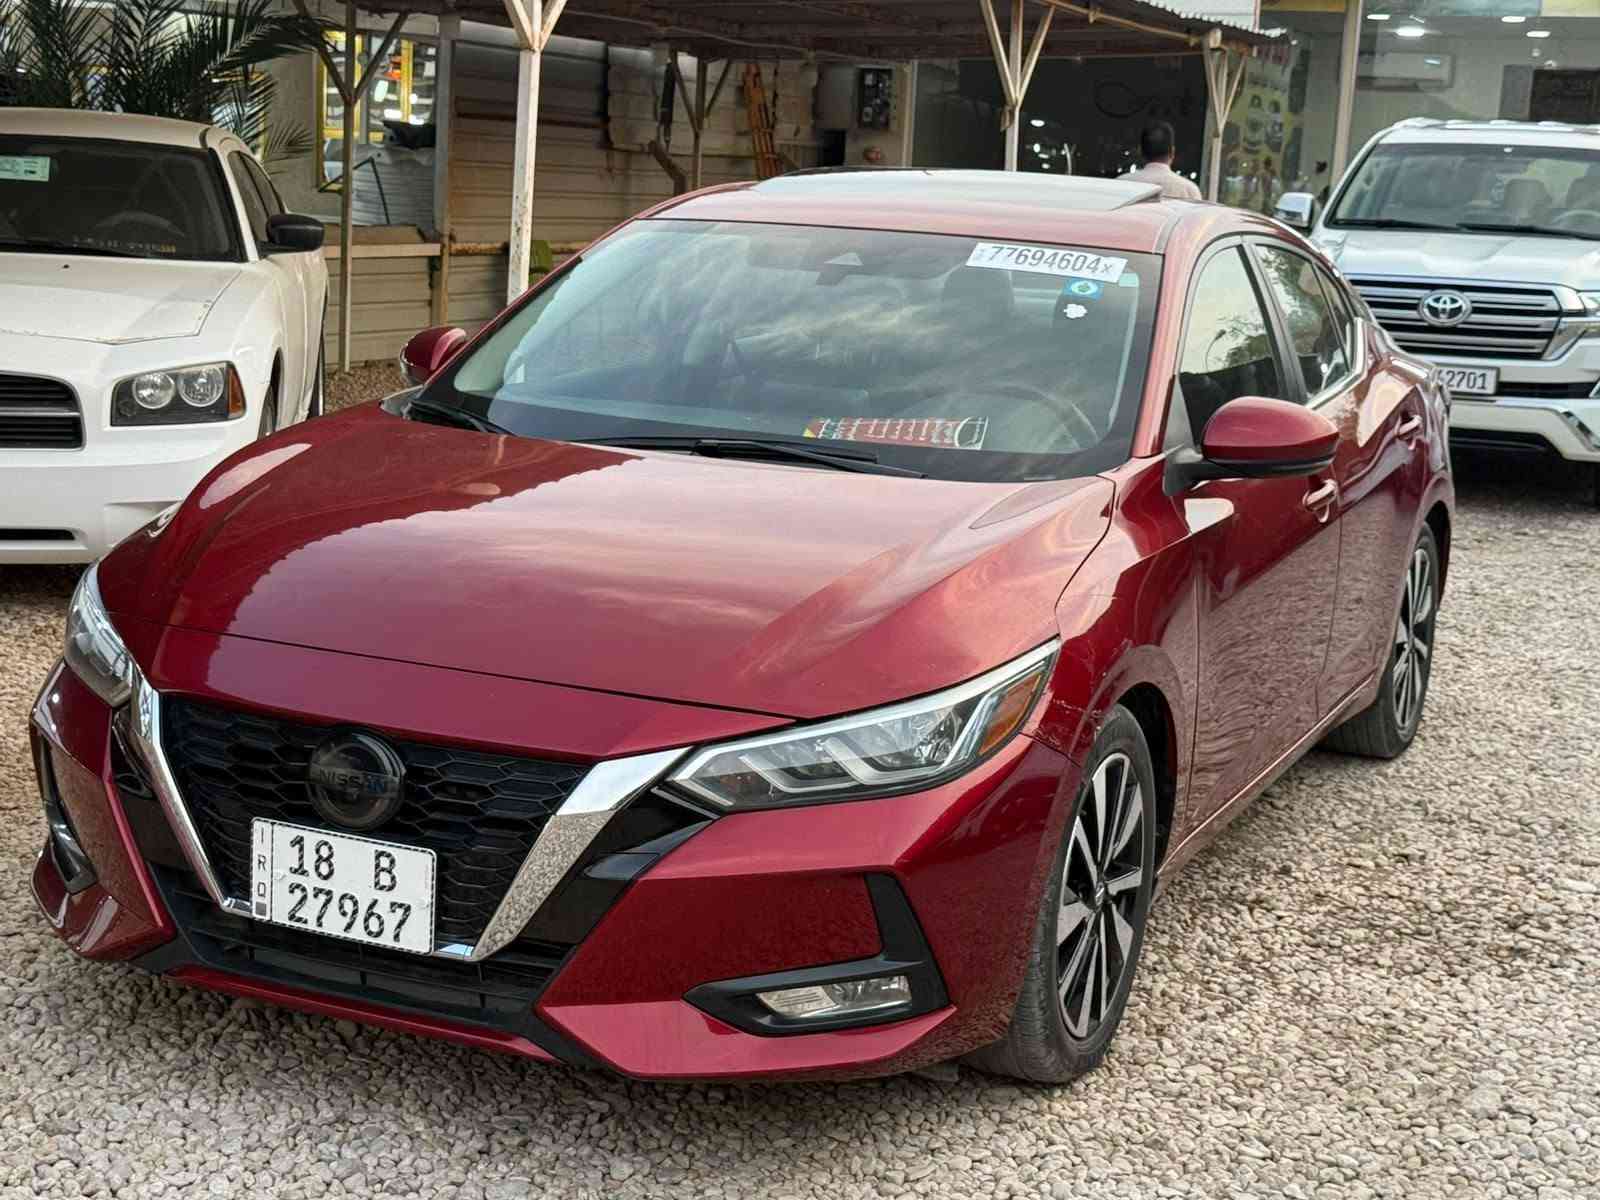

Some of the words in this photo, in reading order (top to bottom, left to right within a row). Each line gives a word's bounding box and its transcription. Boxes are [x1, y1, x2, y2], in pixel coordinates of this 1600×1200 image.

[289, 835, 335, 881] 18
[374, 849, 397, 892] B
[287, 882, 412, 943] 27967
